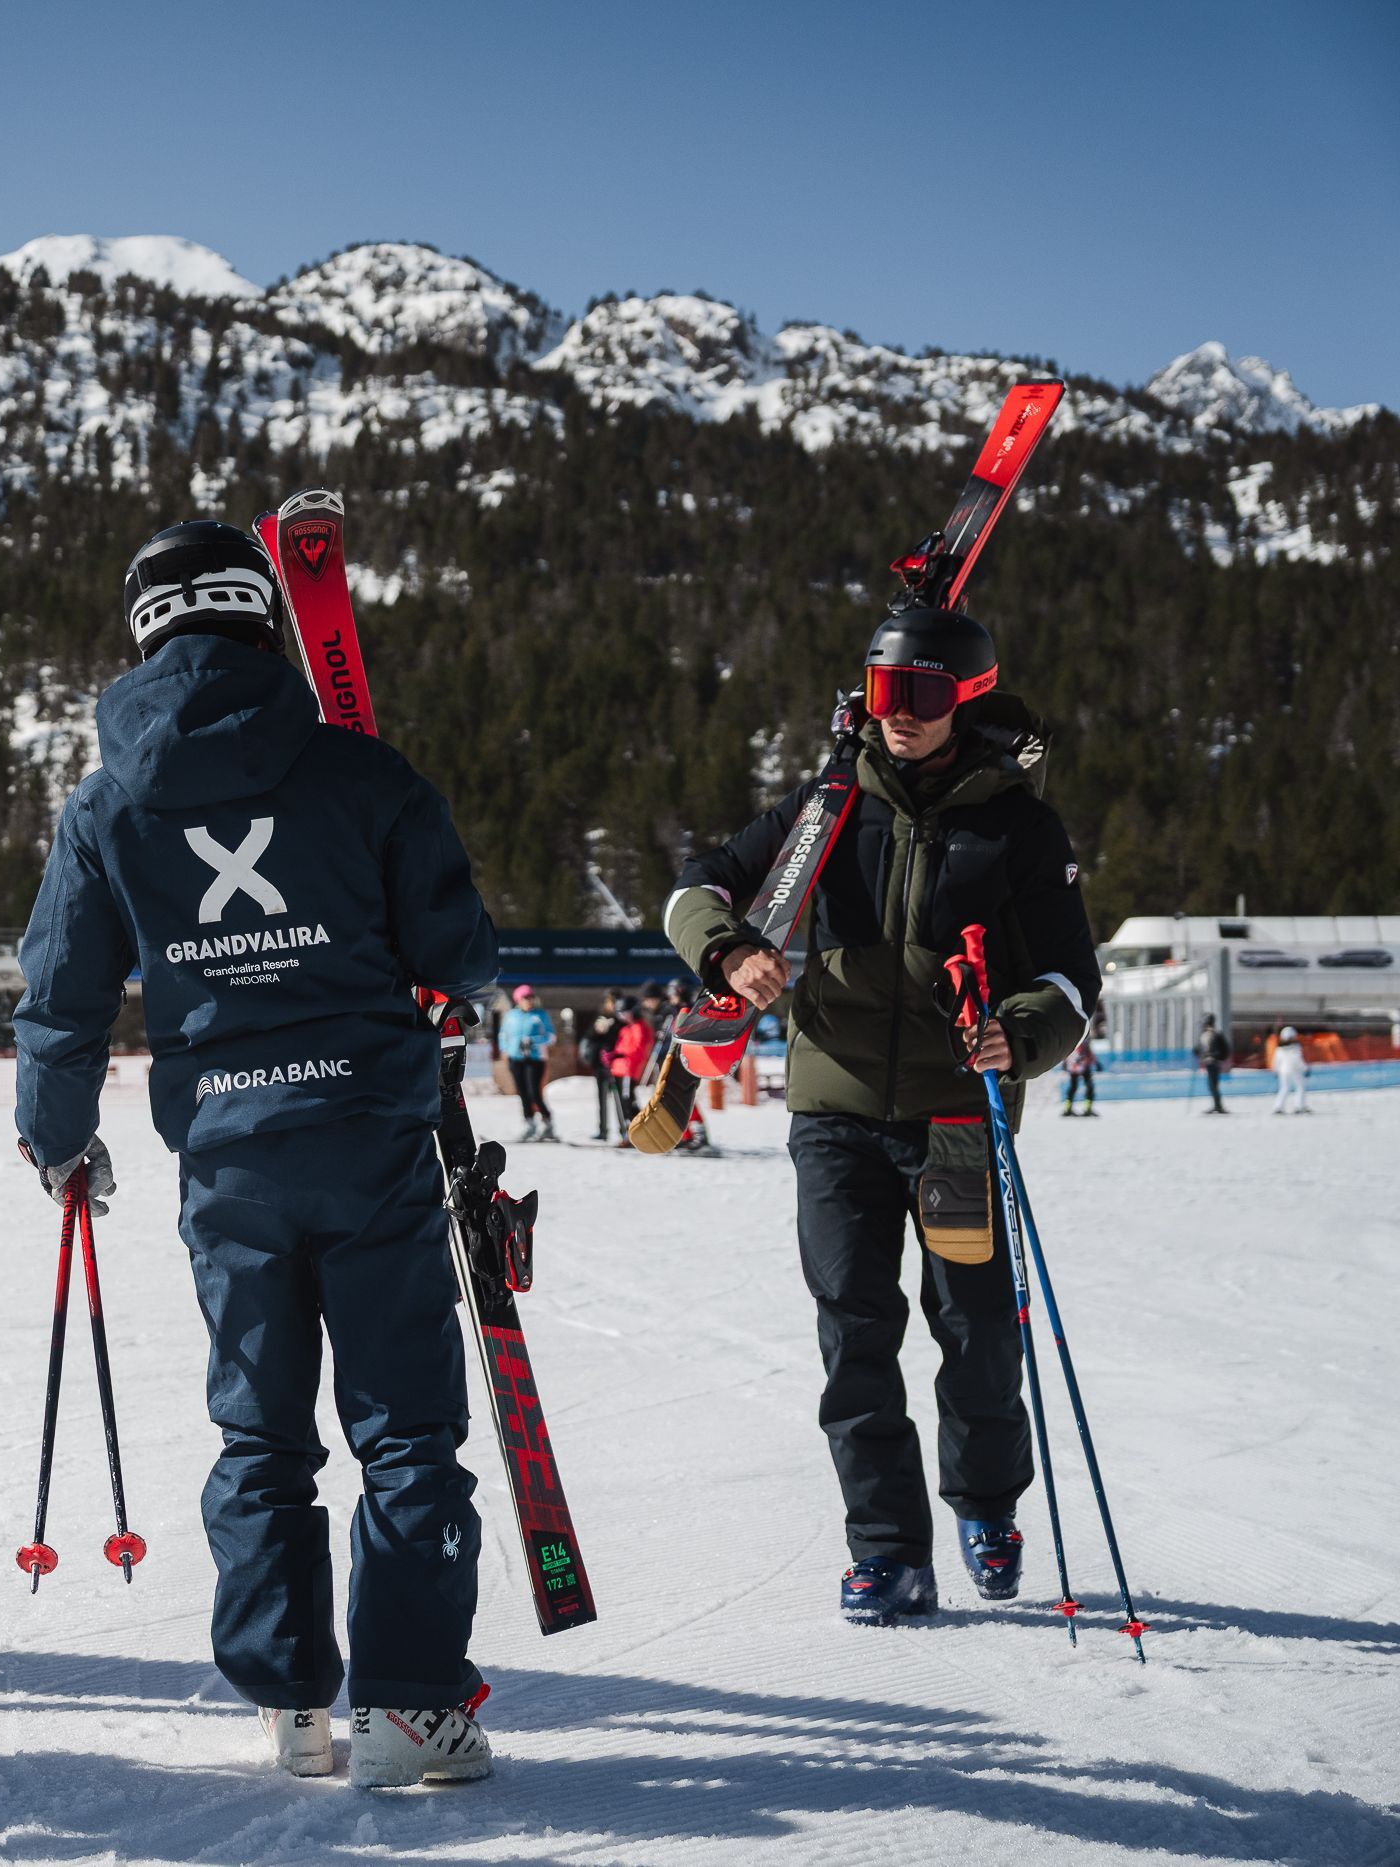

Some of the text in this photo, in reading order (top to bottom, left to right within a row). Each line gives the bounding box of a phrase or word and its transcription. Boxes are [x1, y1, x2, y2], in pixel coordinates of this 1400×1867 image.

[912, 659, 945, 671] GIRO
[767, 823, 822, 909] ROSSIGNOL
[165, 923, 331, 964] GRANDVALIRA
[203, 957, 300, 978] Grandvalira Resorts
[229, 973, 281, 987] ANDORRA
[212, 1059, 353, 1095] MORABANC
[541, 1541, 567, 1563] E14
[546, 1577, 564, 1592] 172
[388, 1711, 424, 1746] ROSSIGNOL
